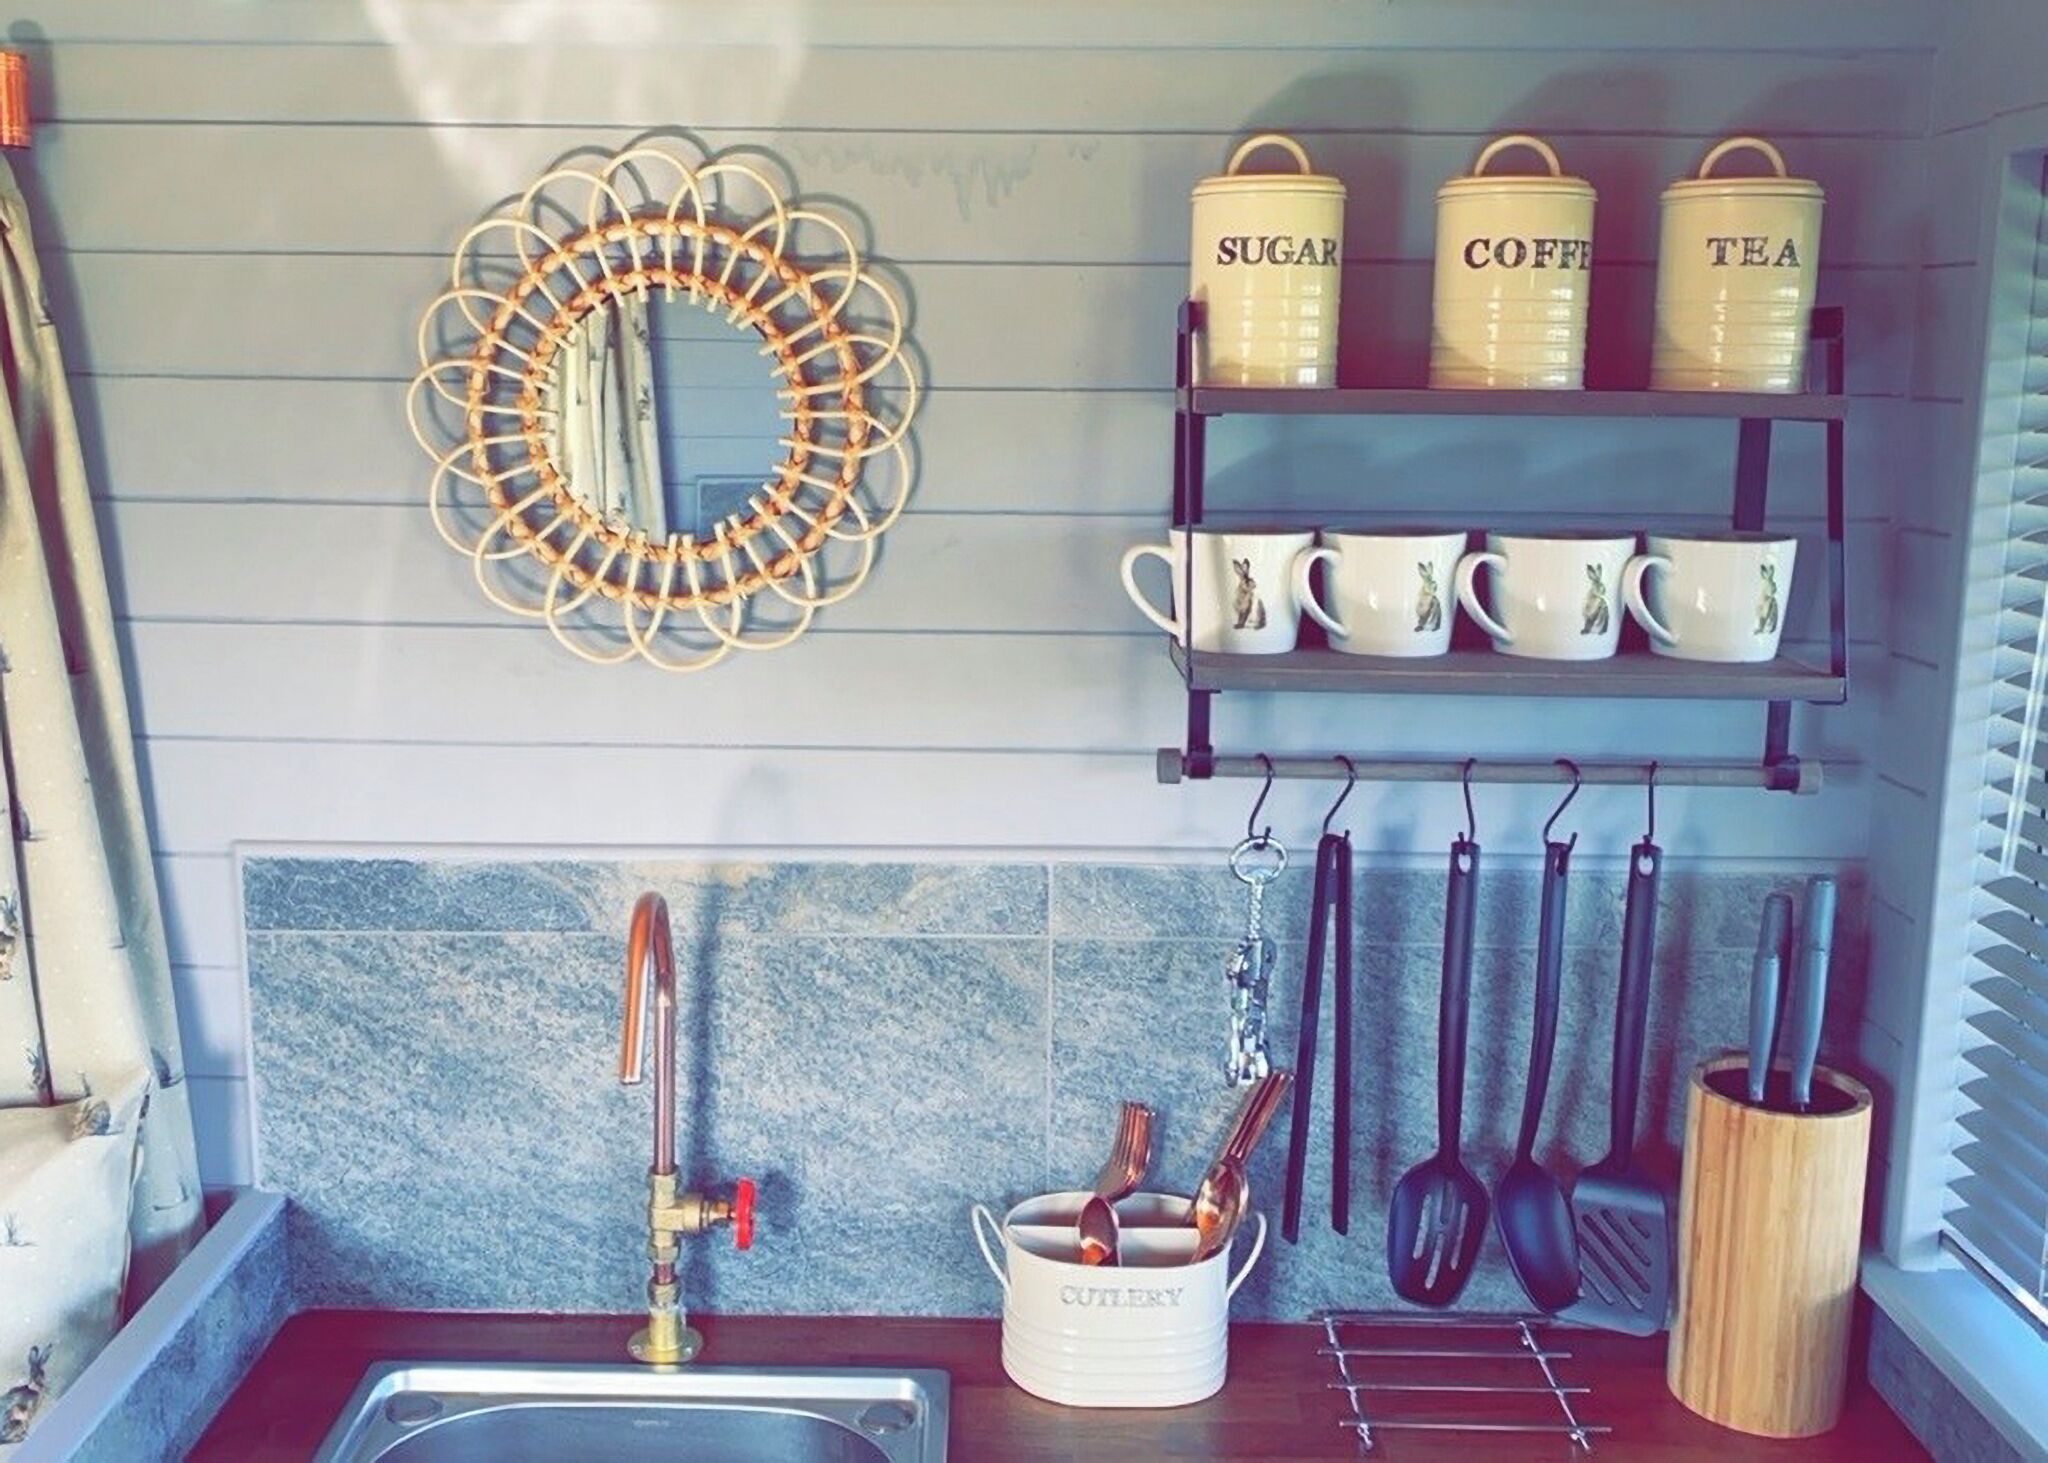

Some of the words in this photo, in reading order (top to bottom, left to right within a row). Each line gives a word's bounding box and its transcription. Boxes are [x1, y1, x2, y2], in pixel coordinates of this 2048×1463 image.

[1217, 236, 1338, 266] SUGAR
[1706, 237, 1801, 267] TEA
[1060, 1285, 1184, 1307] CUTLERY
